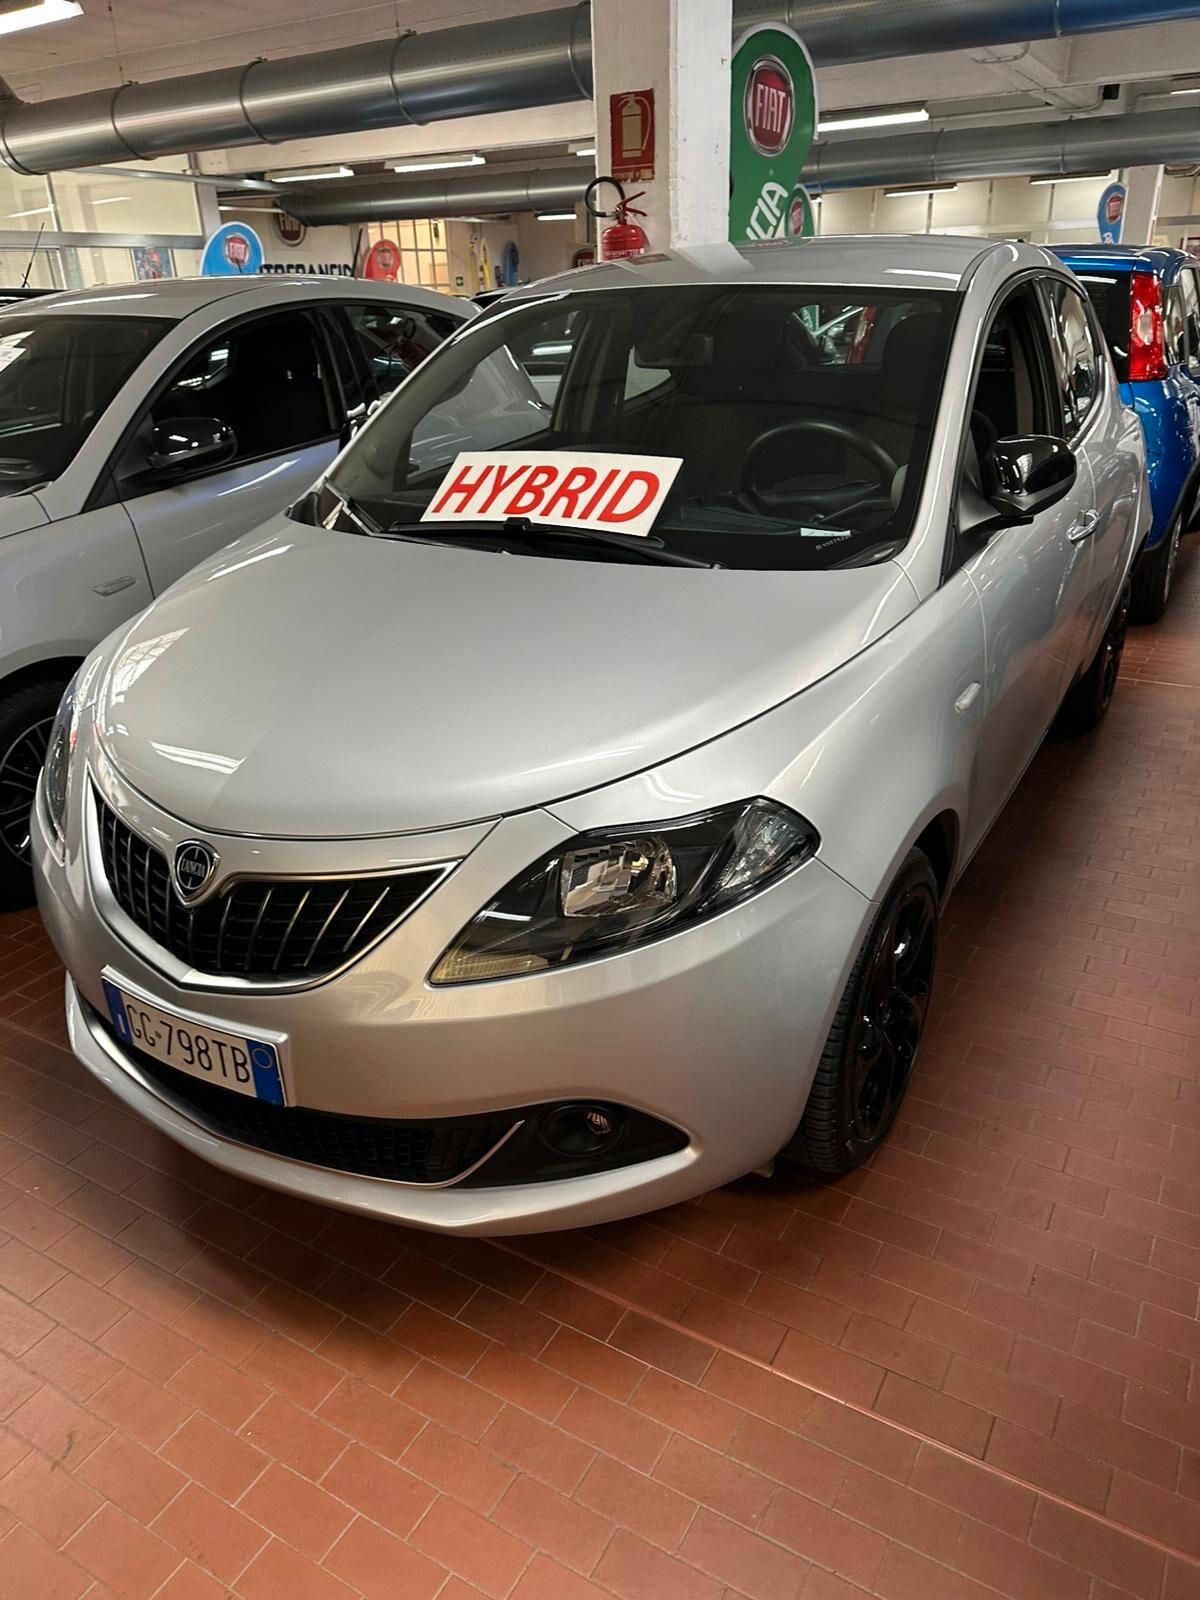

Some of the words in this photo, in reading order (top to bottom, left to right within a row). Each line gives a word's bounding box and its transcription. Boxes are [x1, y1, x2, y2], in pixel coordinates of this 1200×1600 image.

[755, 83, 787, 133] FIAT
[432, 465, 661, 523] HYBRID
[180, 858, 206, 878] LANCIA
